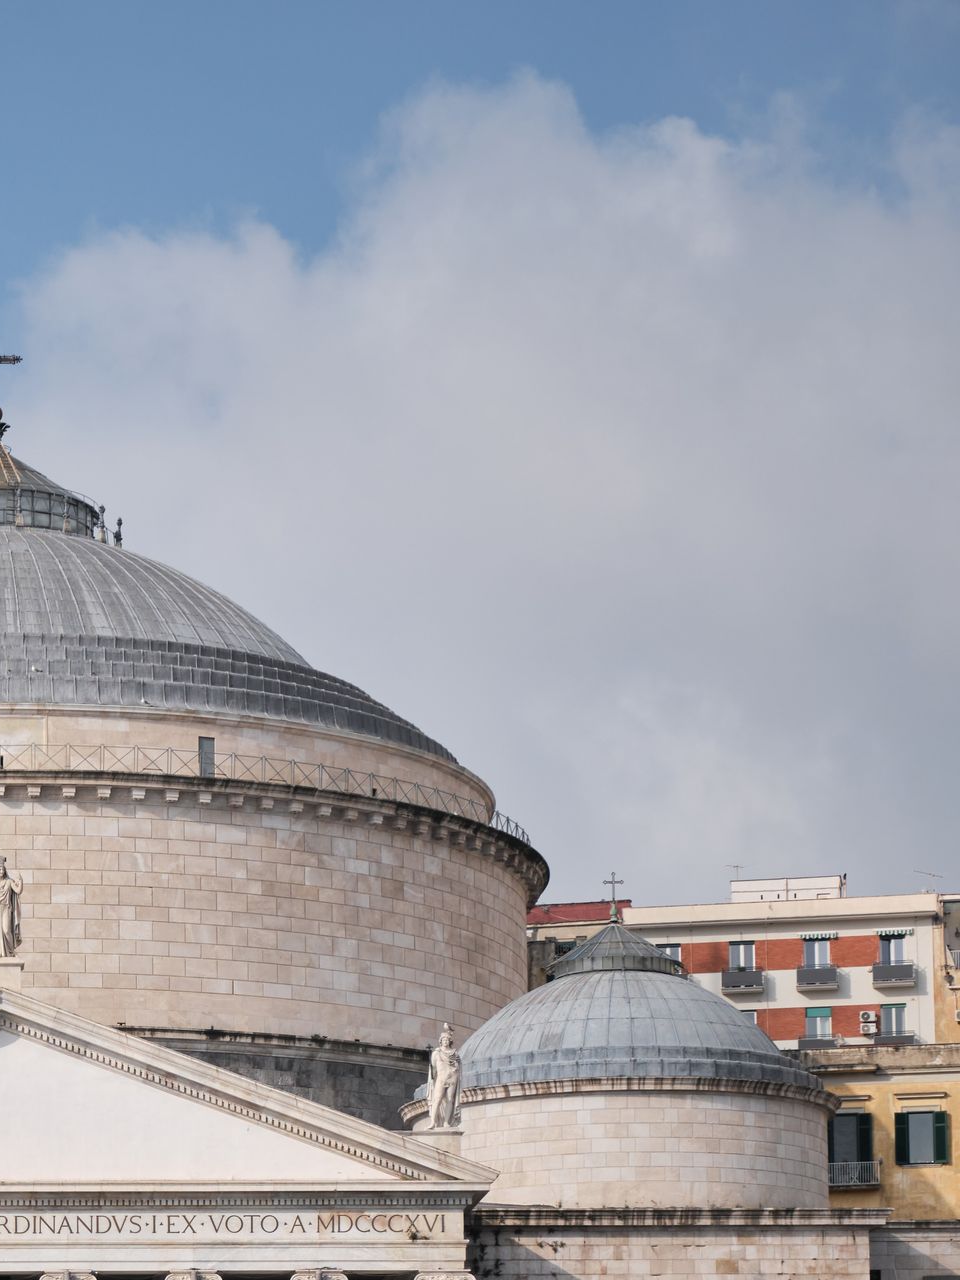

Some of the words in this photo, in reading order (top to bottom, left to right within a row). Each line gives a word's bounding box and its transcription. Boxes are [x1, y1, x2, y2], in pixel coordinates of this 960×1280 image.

[151, 1215, 157, 1234] I
[166, 1215, 197, 1234] EX
[208, 1215, 280, 1234] VOTO
[289, 1215, 307, 1234] A
[316, 1214, 446, 1234] MDCCCXVI
